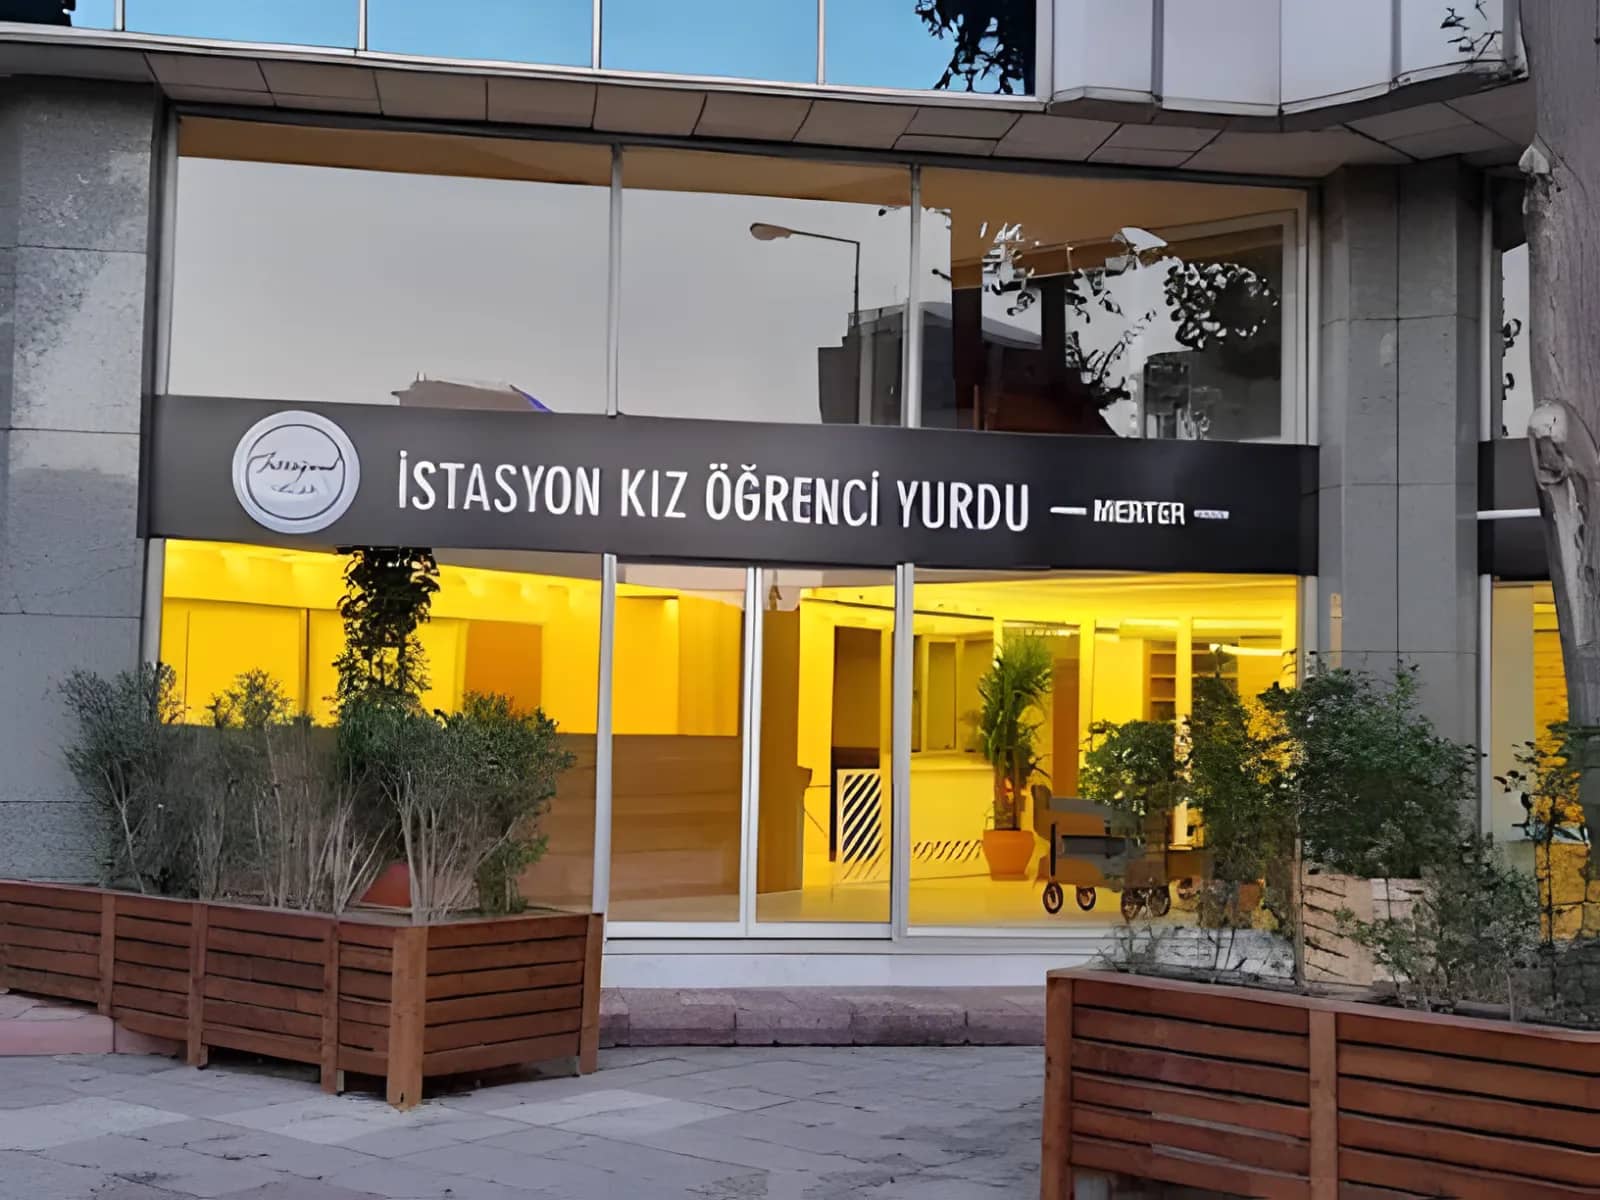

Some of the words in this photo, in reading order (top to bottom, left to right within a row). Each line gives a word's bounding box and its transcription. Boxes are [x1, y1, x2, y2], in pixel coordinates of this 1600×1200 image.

[398, 449, 601, 517] İSTASYON
[620, 468, 689, 519] KIZ
[705, 462, 880, 527] ÖĞRENCİ
[896, 479, 1029, 532] YURDU
